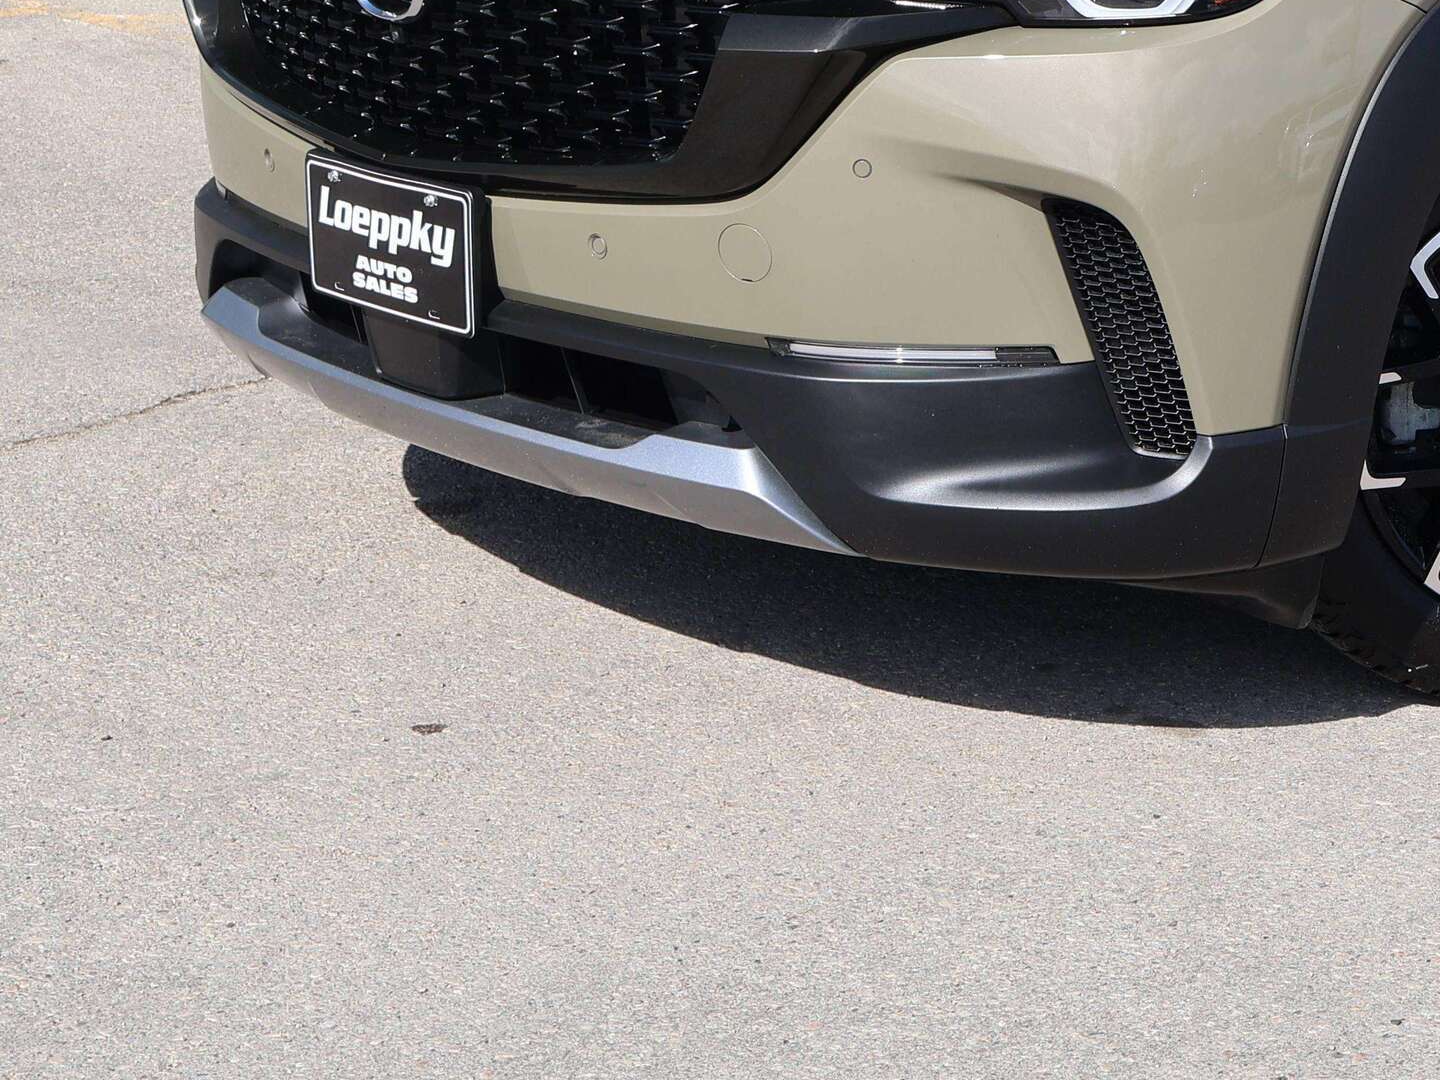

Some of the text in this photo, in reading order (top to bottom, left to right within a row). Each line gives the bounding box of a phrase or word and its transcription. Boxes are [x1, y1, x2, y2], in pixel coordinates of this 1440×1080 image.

[318, 185, 457, 268] Loeppky
[355, 254, 413, 283] AUTO
[352, 271, 419, 304] SALES
